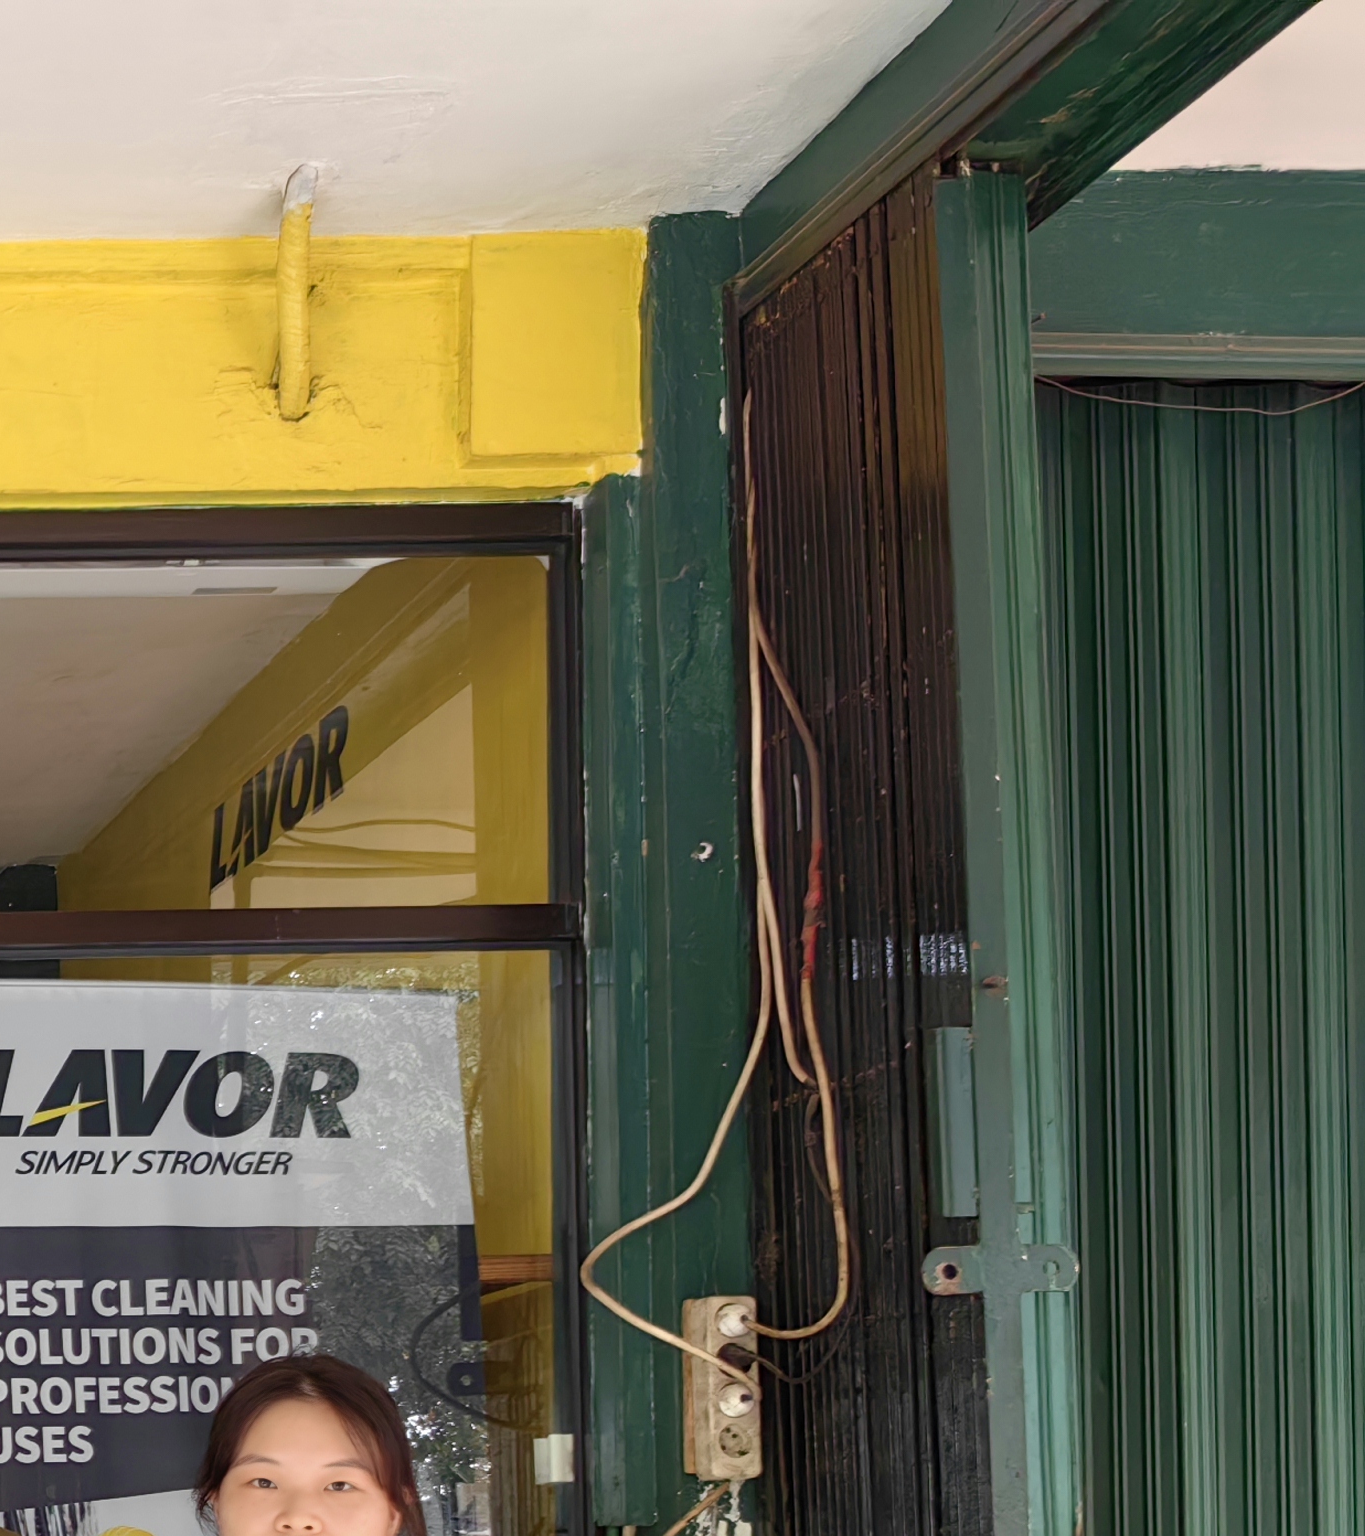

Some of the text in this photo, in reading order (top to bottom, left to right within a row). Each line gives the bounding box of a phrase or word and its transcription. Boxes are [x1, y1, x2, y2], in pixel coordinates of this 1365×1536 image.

[209, 704, 349, 895] LAVOR
[15, 1150, 294, 1176] SIMPLY STRONGER
[91, 1278, 306, 1317] CLEANING
